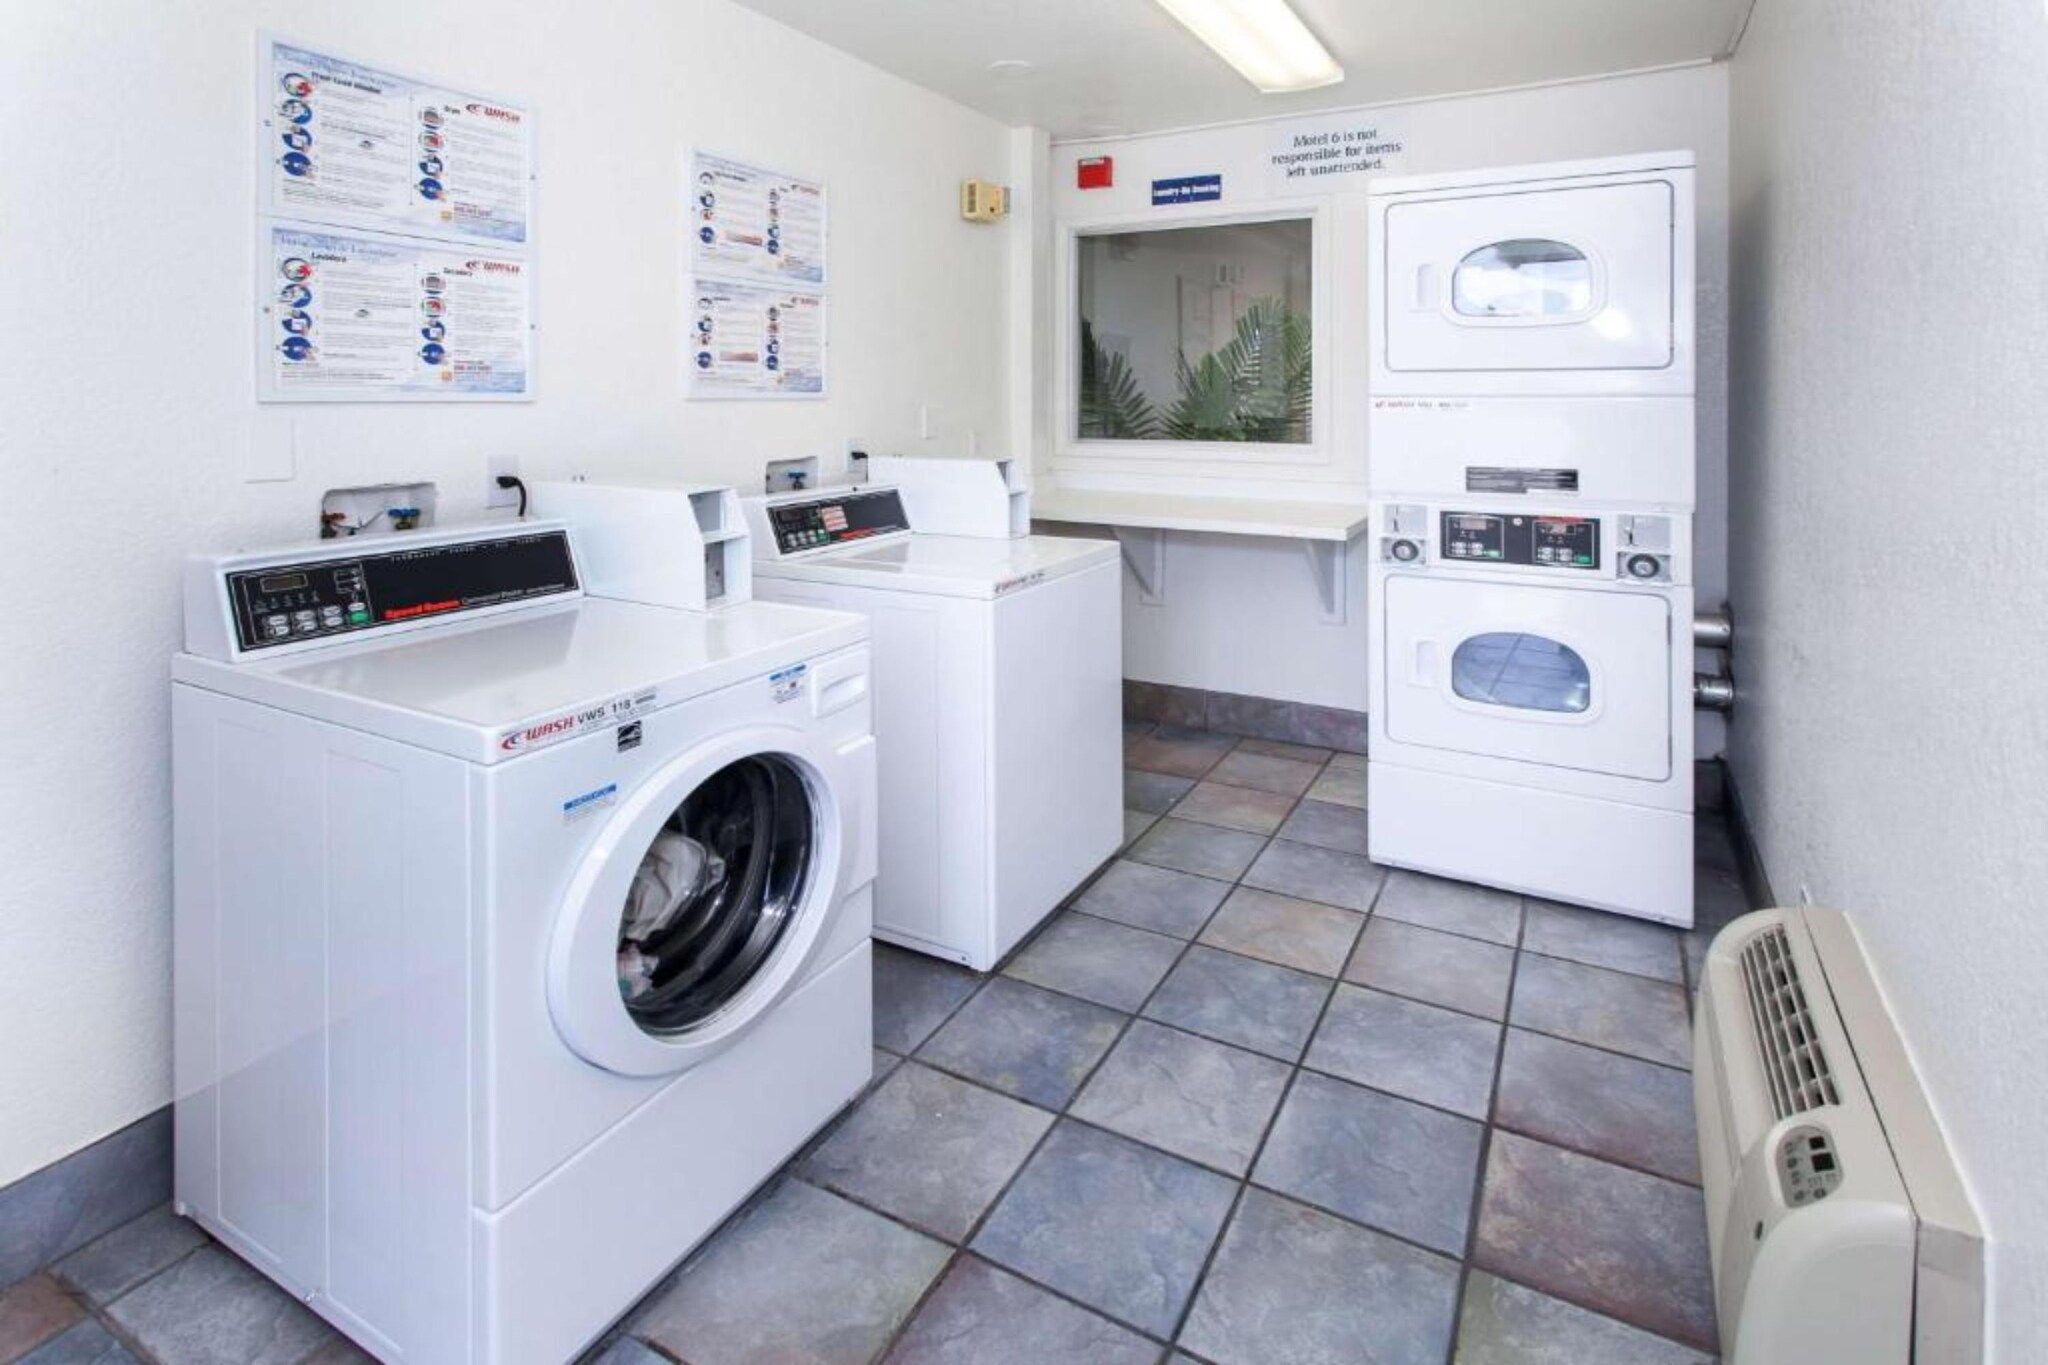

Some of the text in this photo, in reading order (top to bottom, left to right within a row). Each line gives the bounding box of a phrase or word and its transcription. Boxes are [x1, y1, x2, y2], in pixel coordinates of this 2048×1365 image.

[1293, 129, 1377, 148] Motel 6 is not
[1271, 142, 1402, 165] responsible for items
[1286, 165, 1306, 177] left
[525, 715, 576, 741] WASH
